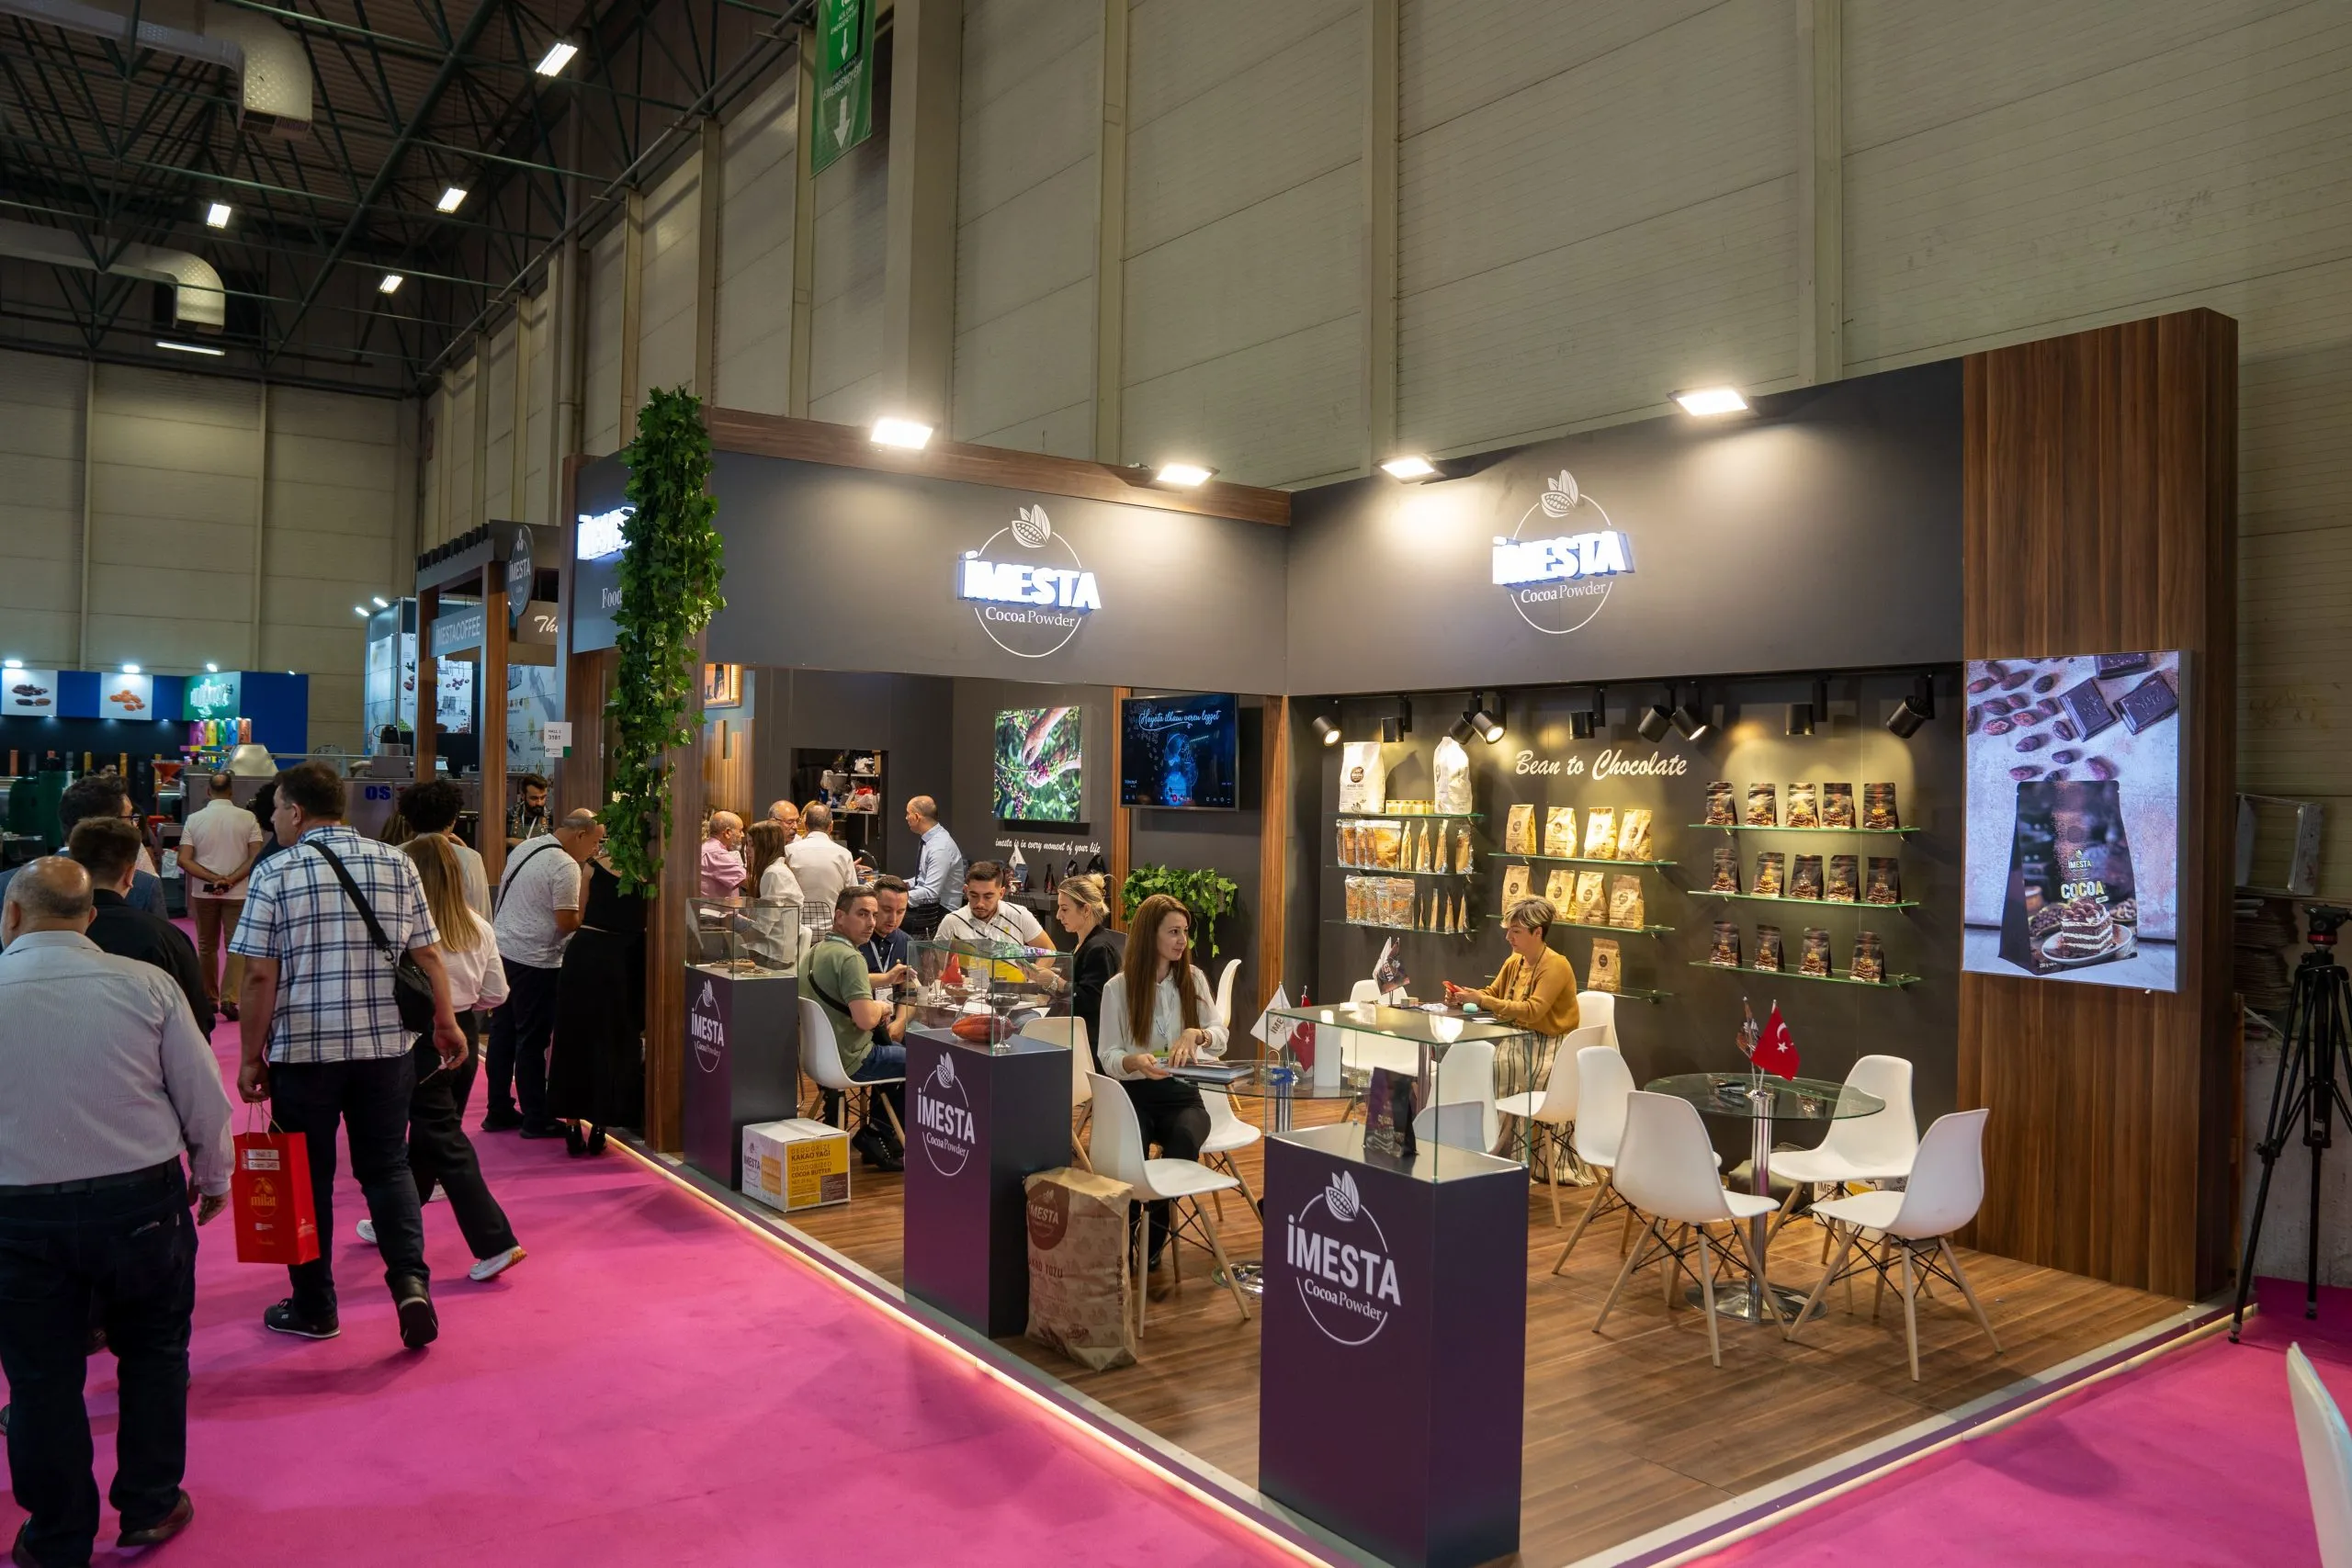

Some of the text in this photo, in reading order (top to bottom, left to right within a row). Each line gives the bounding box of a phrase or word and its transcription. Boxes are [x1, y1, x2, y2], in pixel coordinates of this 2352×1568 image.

[1521, 581, 1607, 604] Cocoa Powder
[985, 606, 1075, 627] Cocoa Powder
[1515, 749, 1688, 781] Bean to Chocolate
[1020, 839, 1027, 849] in
[1027, 841, 1043, 853] every
[1043, 841, 1066, 852] moment
[1066, 840, 1074, 855] of
[1074, 844, 1089, 855] your
[1089, 841, 1101, 857] life
[2060, 880, 2105, 899] COCOA
[926, 1132, 967, 1157] Cocoa Powder
[791, 1149, 831, 1162] KAKAO YAĞI
[791, 1170, 810, 1179] COCOA
[1304, 1278, 1383, 1321] Cocoa Powder
